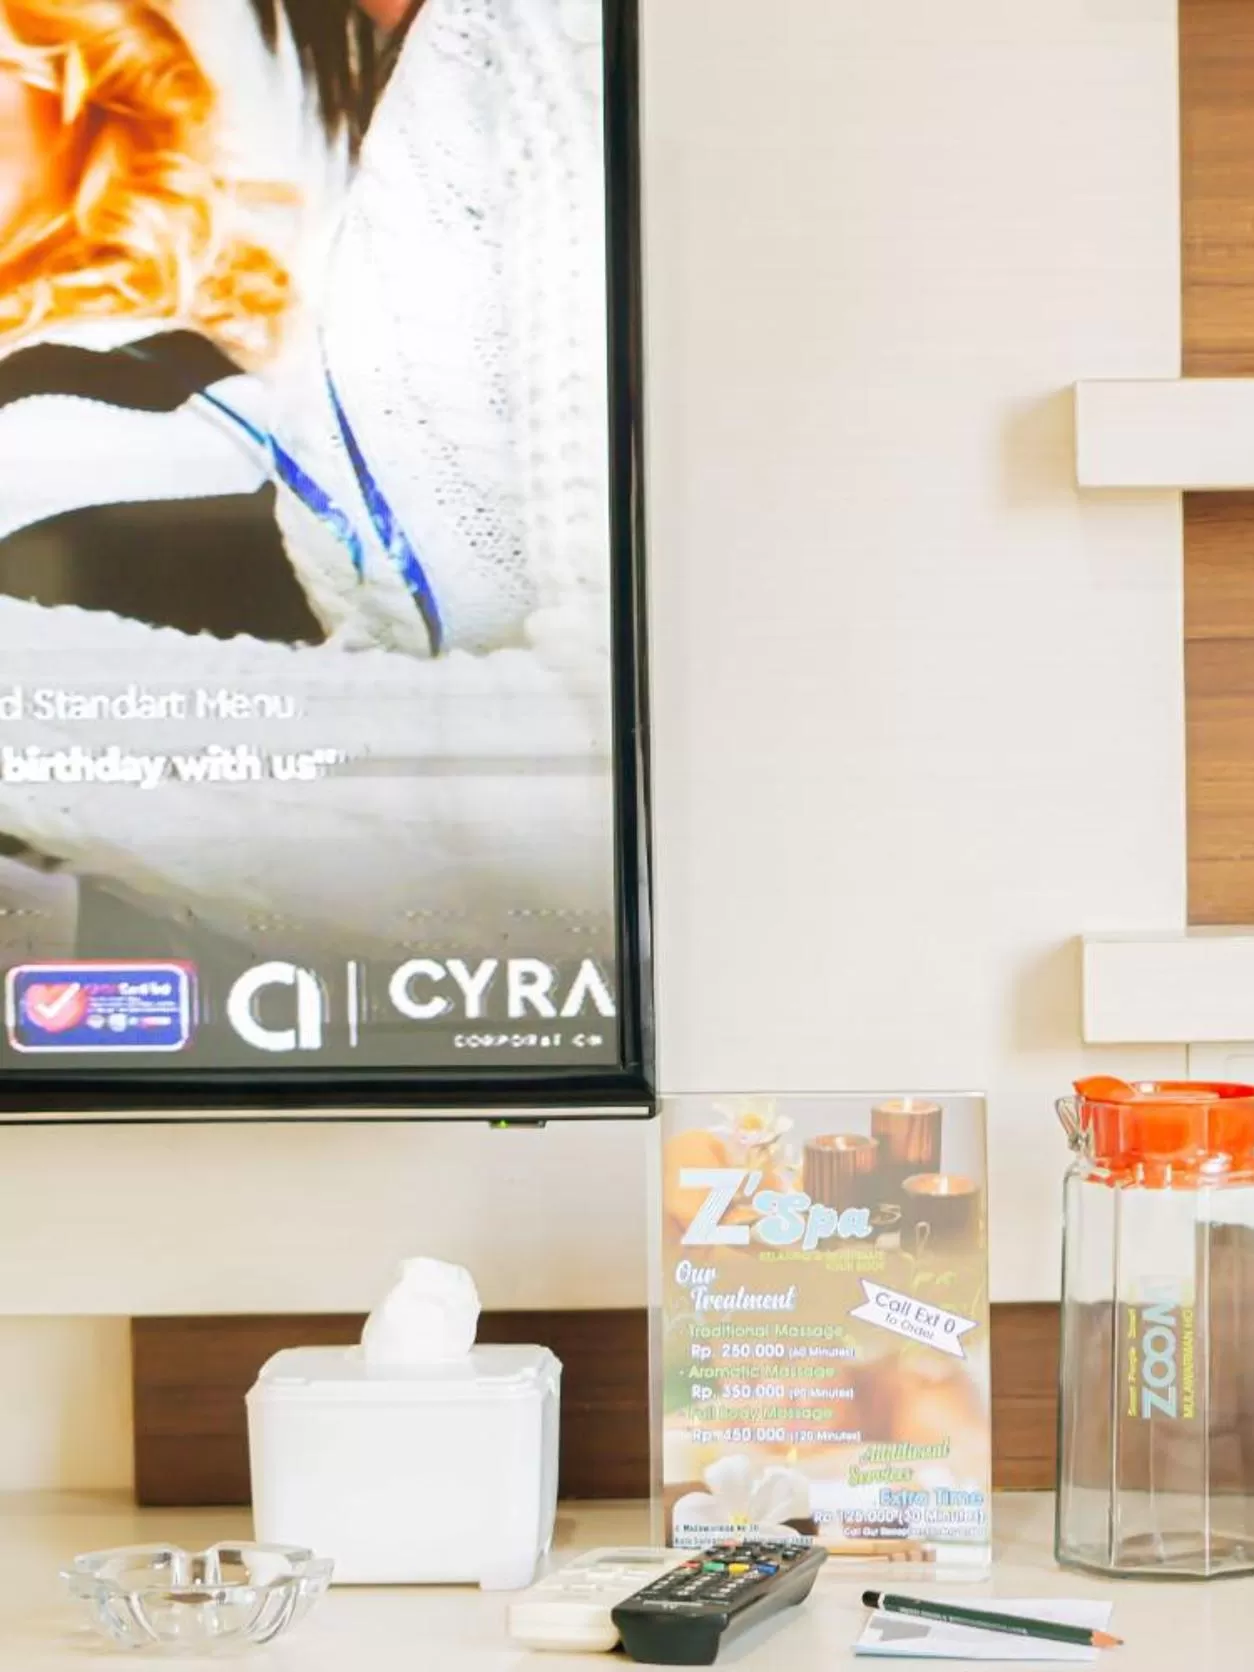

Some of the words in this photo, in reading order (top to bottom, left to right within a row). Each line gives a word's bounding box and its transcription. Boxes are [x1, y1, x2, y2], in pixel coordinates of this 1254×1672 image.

[33, 687, 186, 719] Standart
[3, 746, 164, 789] birthday
[172, 745, 263, 782] with
[675, 1259, 717, 1285] Our
[690, 1284, 797, 1313] Treatment
[875, 1292, 911, 1316] Call
[915, 1306, 940, 1327] Ext
[688, 1324, 769, 1338] Traditional
[775, 1324, 843, 1340] Massage
[901, 1320, 935, 1340] Order
[688, 1365, 760, 1379] Aromatic
[765, 1365, 835, 1381] Massage
[763, 1406, 833, 1422] Massage
[935, 1487, 984, 1506] Time
